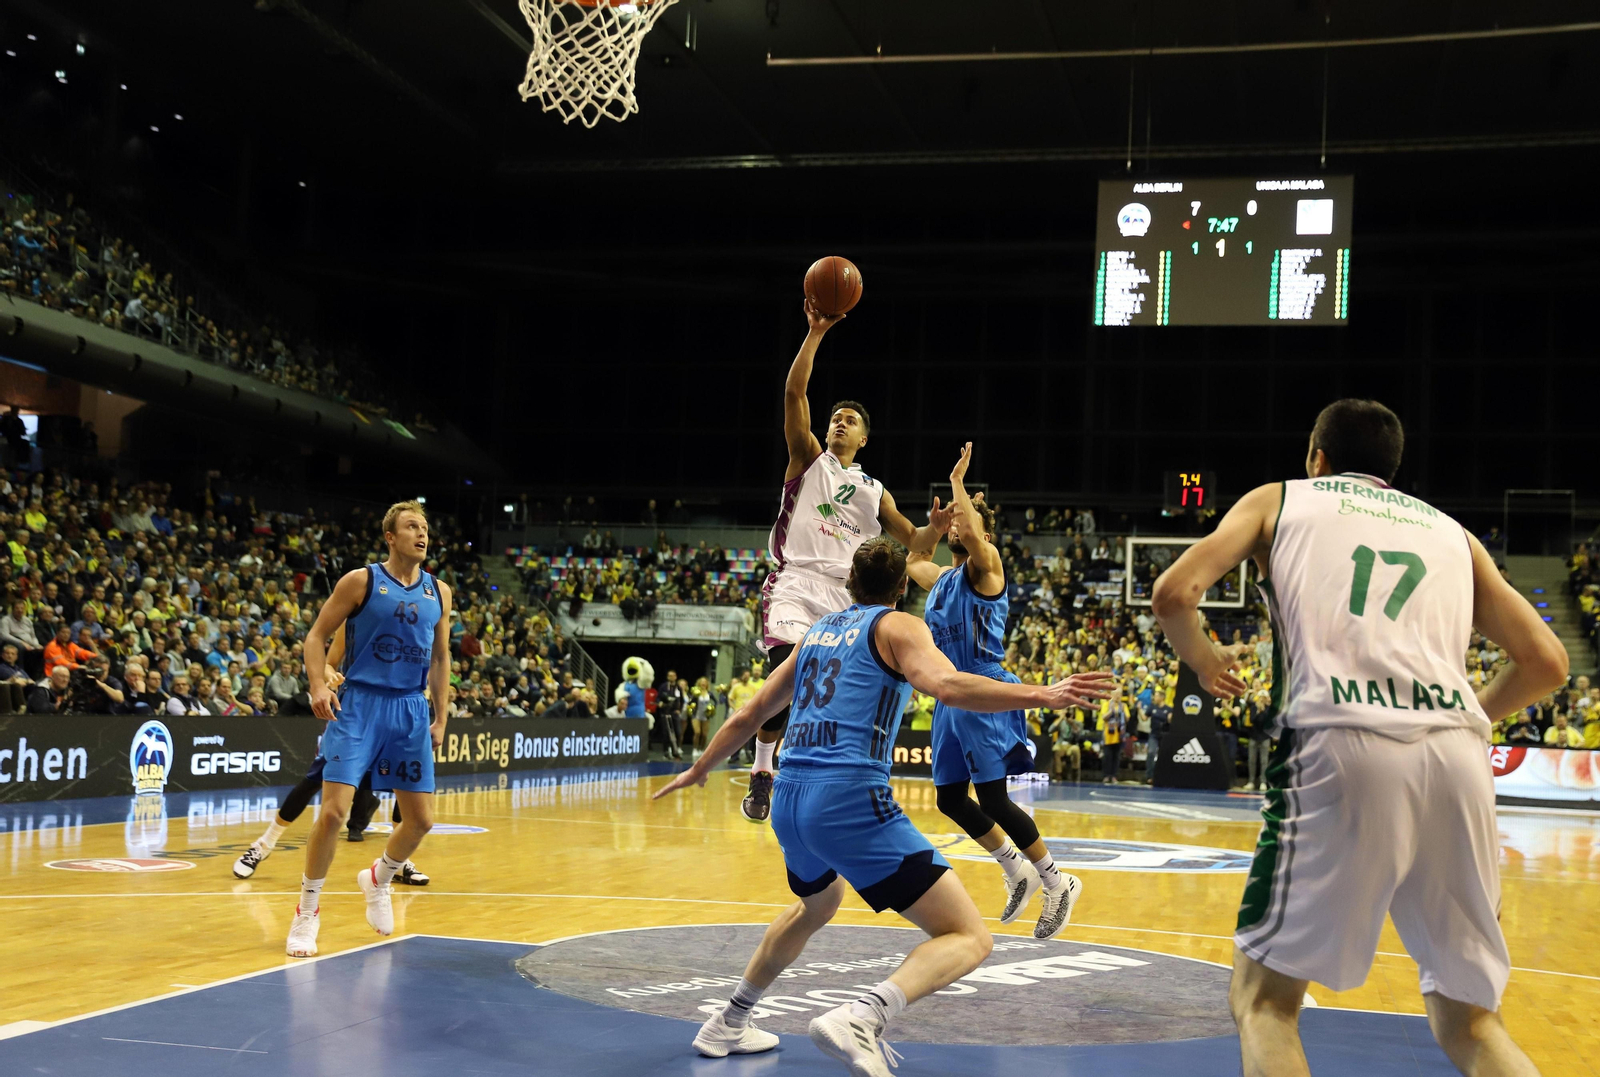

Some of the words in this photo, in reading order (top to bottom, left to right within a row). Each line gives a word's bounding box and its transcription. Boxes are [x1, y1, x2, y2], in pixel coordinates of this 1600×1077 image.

[1191, 201, 1201, 216] 7
[1247, 200, 1258, 215] 0
[1208, 217, 1239, 232] 7:47
[1192, 241, 1199, 255] 1
[1215, 239, 1226, 257] 1
[1245, 241, 1253, 254] 1
[1179, 473, 1201, 487] 7.4
[833, 484, 857, 505] 22
[1181, 488, 1204, 506] 17
[1312, 481, 1438, 519] SHERMADINI
[1349, 544, 1428, 622] 17
[393, 600, 419, 626] 43
[802, 629, 843, 649] ALBA
[370, 642, 433, 657] TECHCEN
[797, 657, 842, 710] 33
[783, 720, 838, 749] BERLIN
[433, 733, 471, 763] LBA
[476, 731, 510, 768] Sieg
[514, 732, 559, 760] Bonus
[562, 730, 641, 757] einstreichen
[1172, 753, 1211, 764] adidas
[137, 763, 165, 781] ALBA
[190, 751, 281, 776] GASAG
[395, 760, 423, 784] 43
[965, 750, 980, 774] 1
[958, 951, 1152, 986] ALBA
